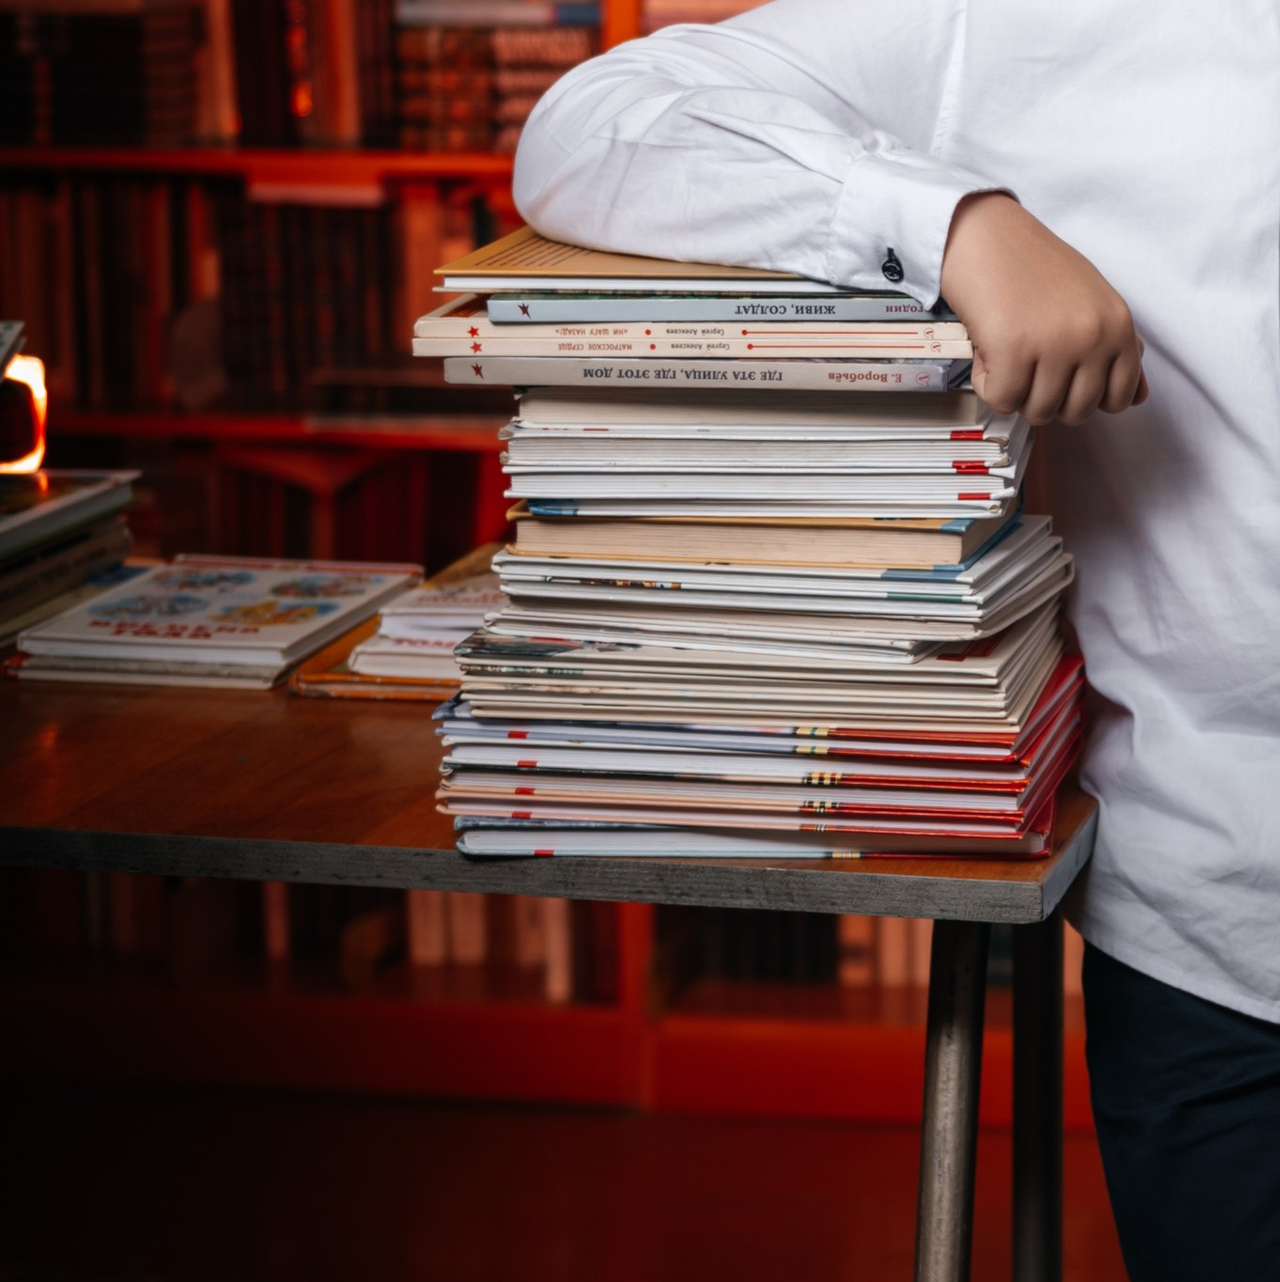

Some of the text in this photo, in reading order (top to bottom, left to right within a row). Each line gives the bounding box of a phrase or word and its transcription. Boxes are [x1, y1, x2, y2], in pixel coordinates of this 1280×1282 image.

[735, 303, 835, 314] ЖИВИ, СОЛДАТ
[702, 327, 724, 335] Сергей
[558, 342, 584, 350] СЕРДЦЕ
[707, 342, 730, 350] Сергей
[584, 367, 782, 381] ГДЕ ЭТА УЛИЦА, ГДЕ ЭТОТ ДОМ
[828, 370, 902, 383] Е. Воробьёв
